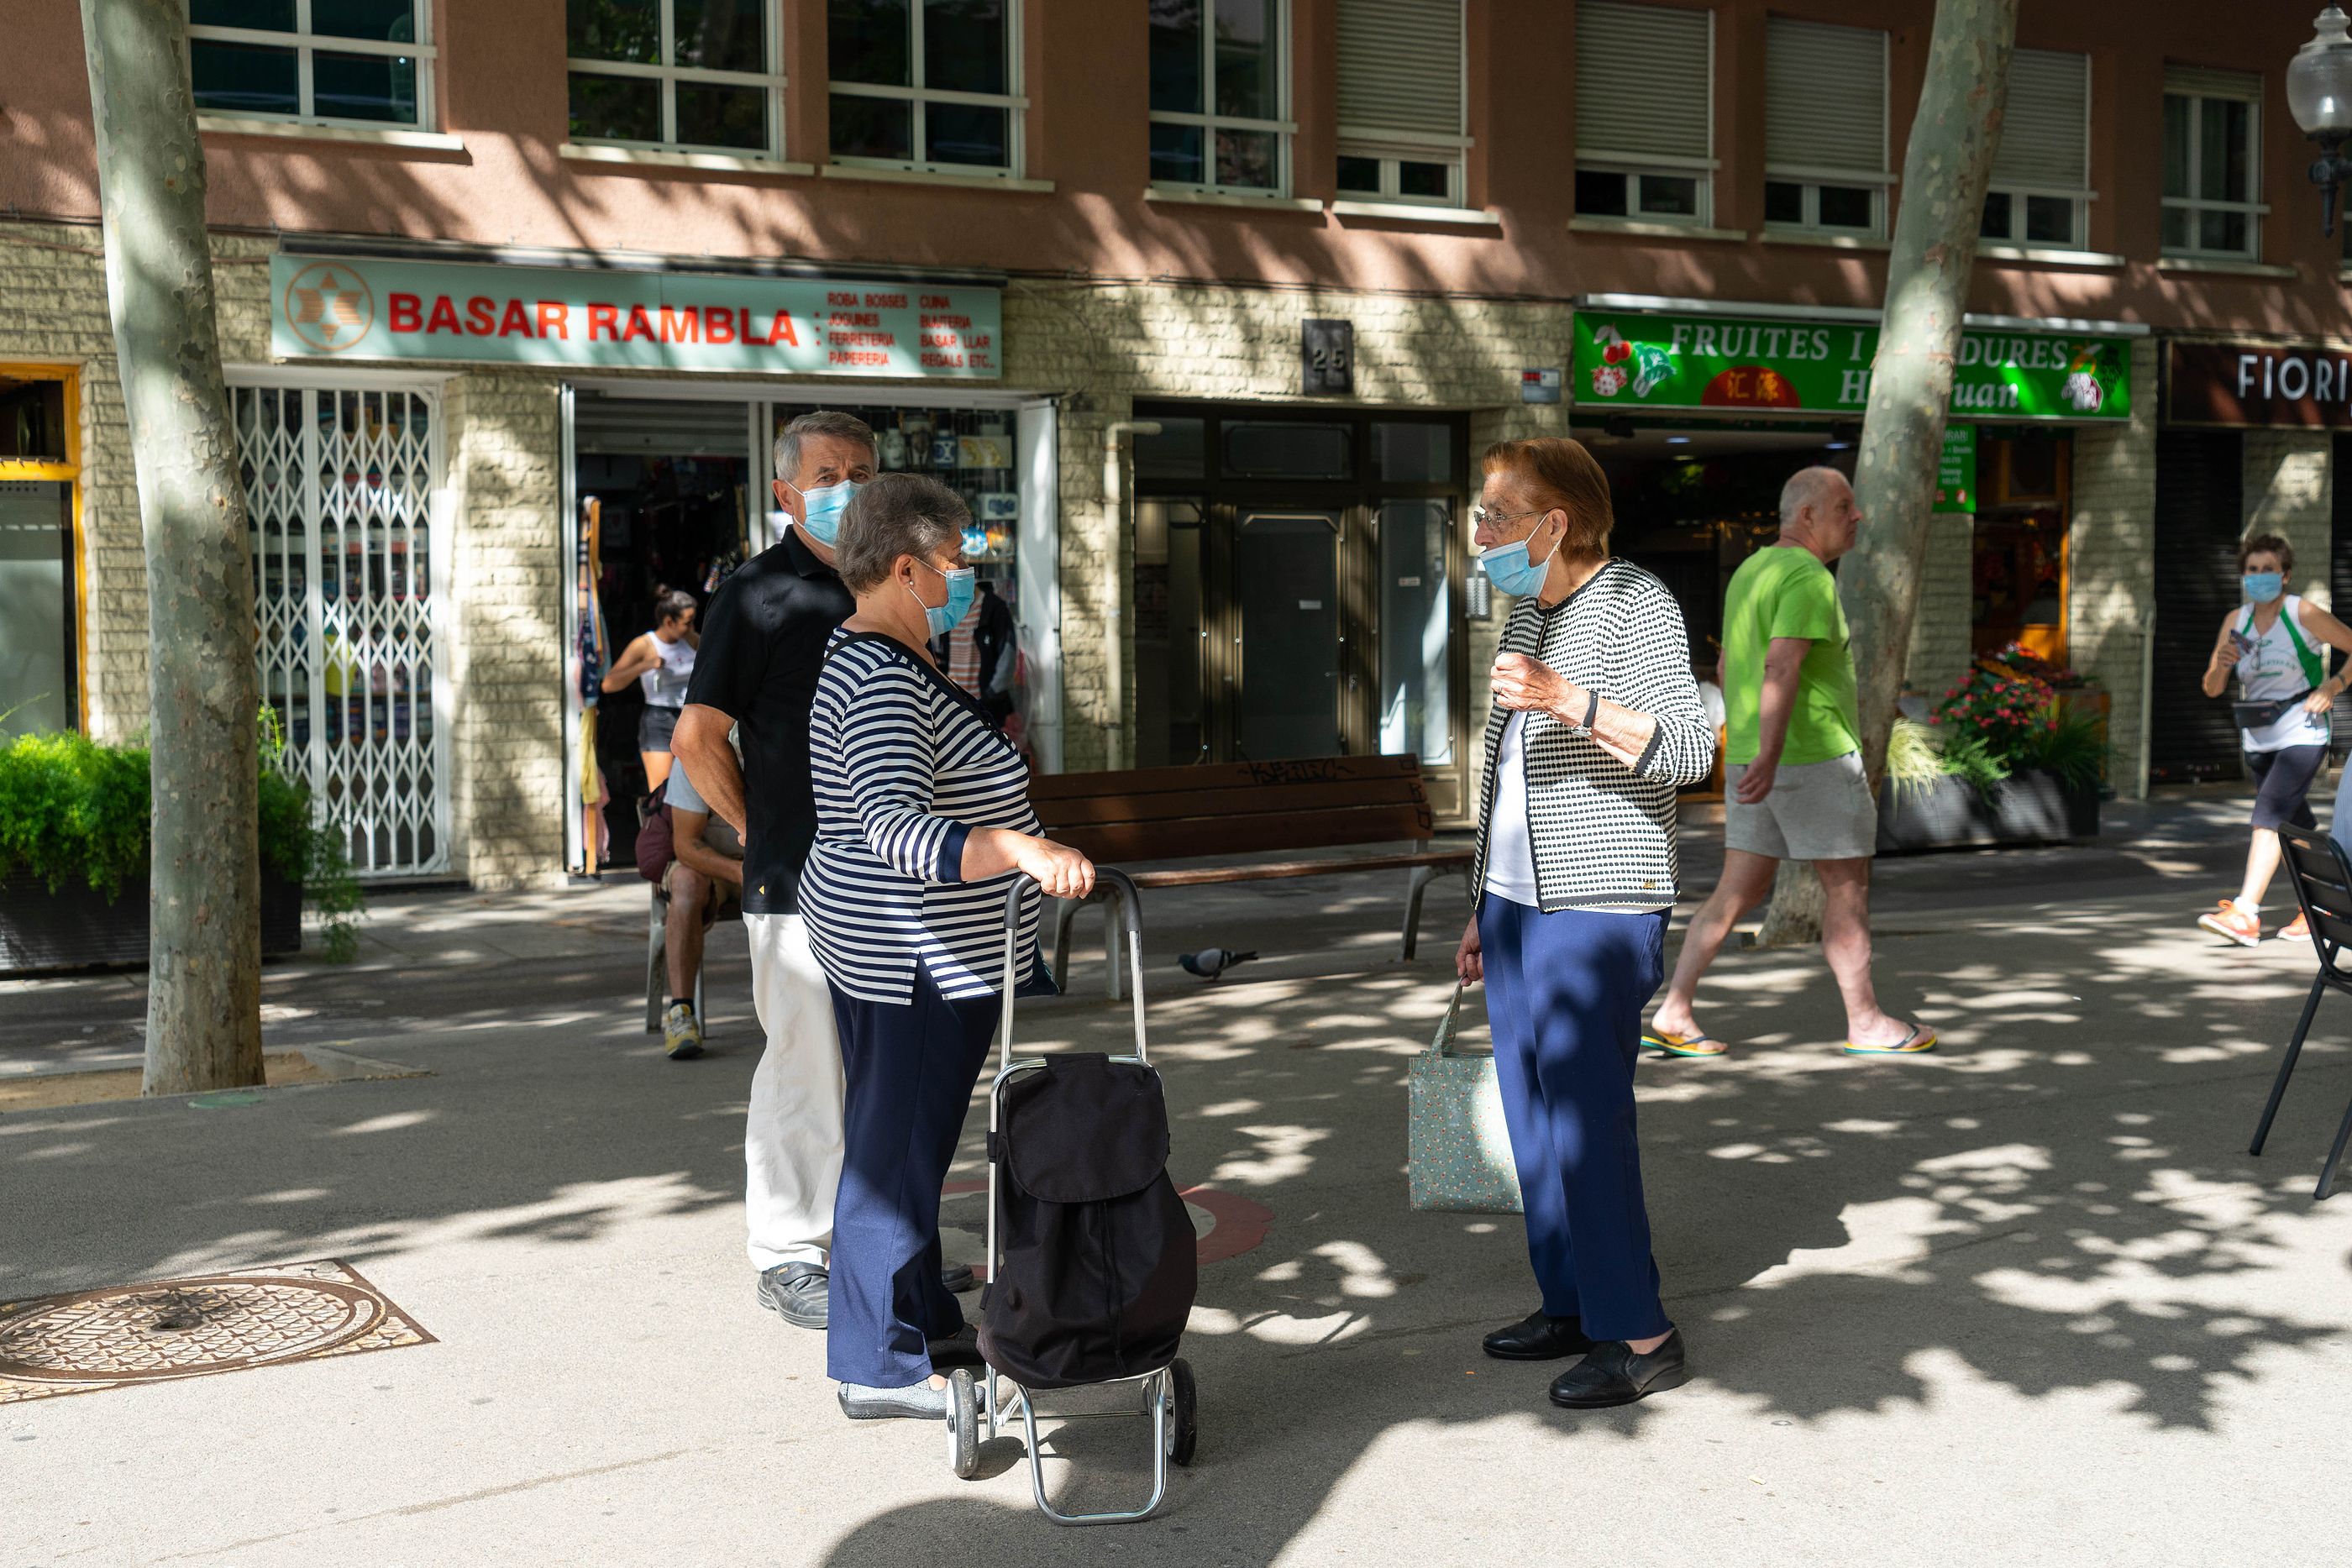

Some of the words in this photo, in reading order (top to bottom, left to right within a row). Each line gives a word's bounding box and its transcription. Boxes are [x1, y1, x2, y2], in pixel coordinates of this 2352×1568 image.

[827, 291, 858, 307] ROBA
[865, 294, 907, 308] BOSSES
[919, 295, 950, 308] CUINA
[388, 292, 569, 339] BASAR
[588, 303, 800, 347] RAMBLA
[828, 312, 879, 326] JOGUINES
[828, 331, 895, 346] FERRETERIA
[920, 333, 956, 347] BASAR
[963, 335, 990, 349] LLAR
[1668, 323, 1830, 359] FRUITES
[1849, 330, 1865, 362] I
[1957, 336, 2068, 370] DURES
[829, 350, 889, 366] PAPERERIA
[921, 354, 963, 368] REGALS
[1312, 348, 1346, 371] 25
